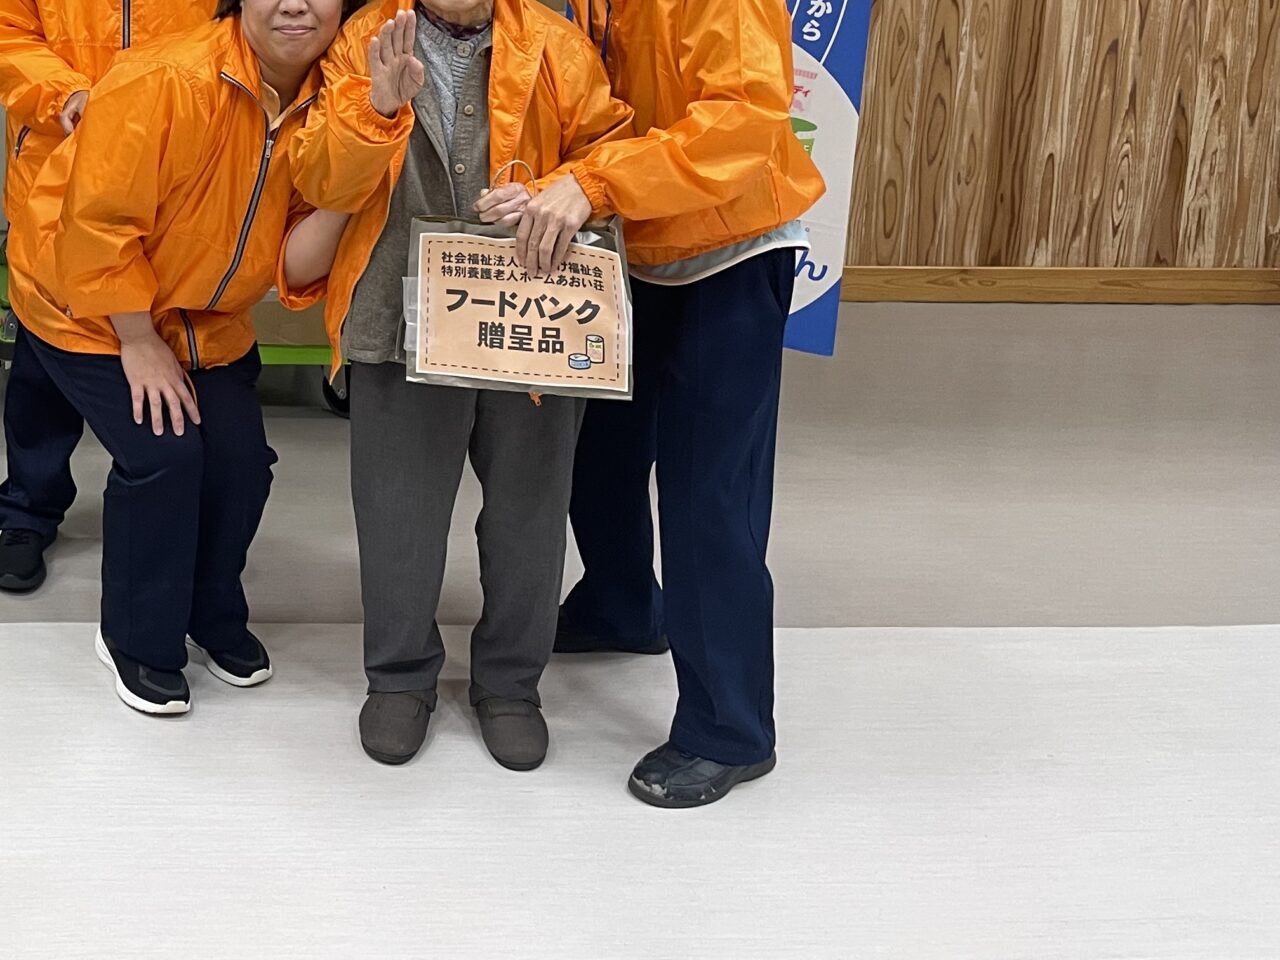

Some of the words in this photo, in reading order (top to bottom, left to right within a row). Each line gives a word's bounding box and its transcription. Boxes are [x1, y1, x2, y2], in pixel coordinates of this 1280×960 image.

[440, 251, 604, 279] 社会福祉法人け福祉会
[440, 266, 605, 292] 特別養護老人ホームあおい荘
[445, 288, 601, 326] フードバンク
[477, 321, 565, 355] 贈呈品
